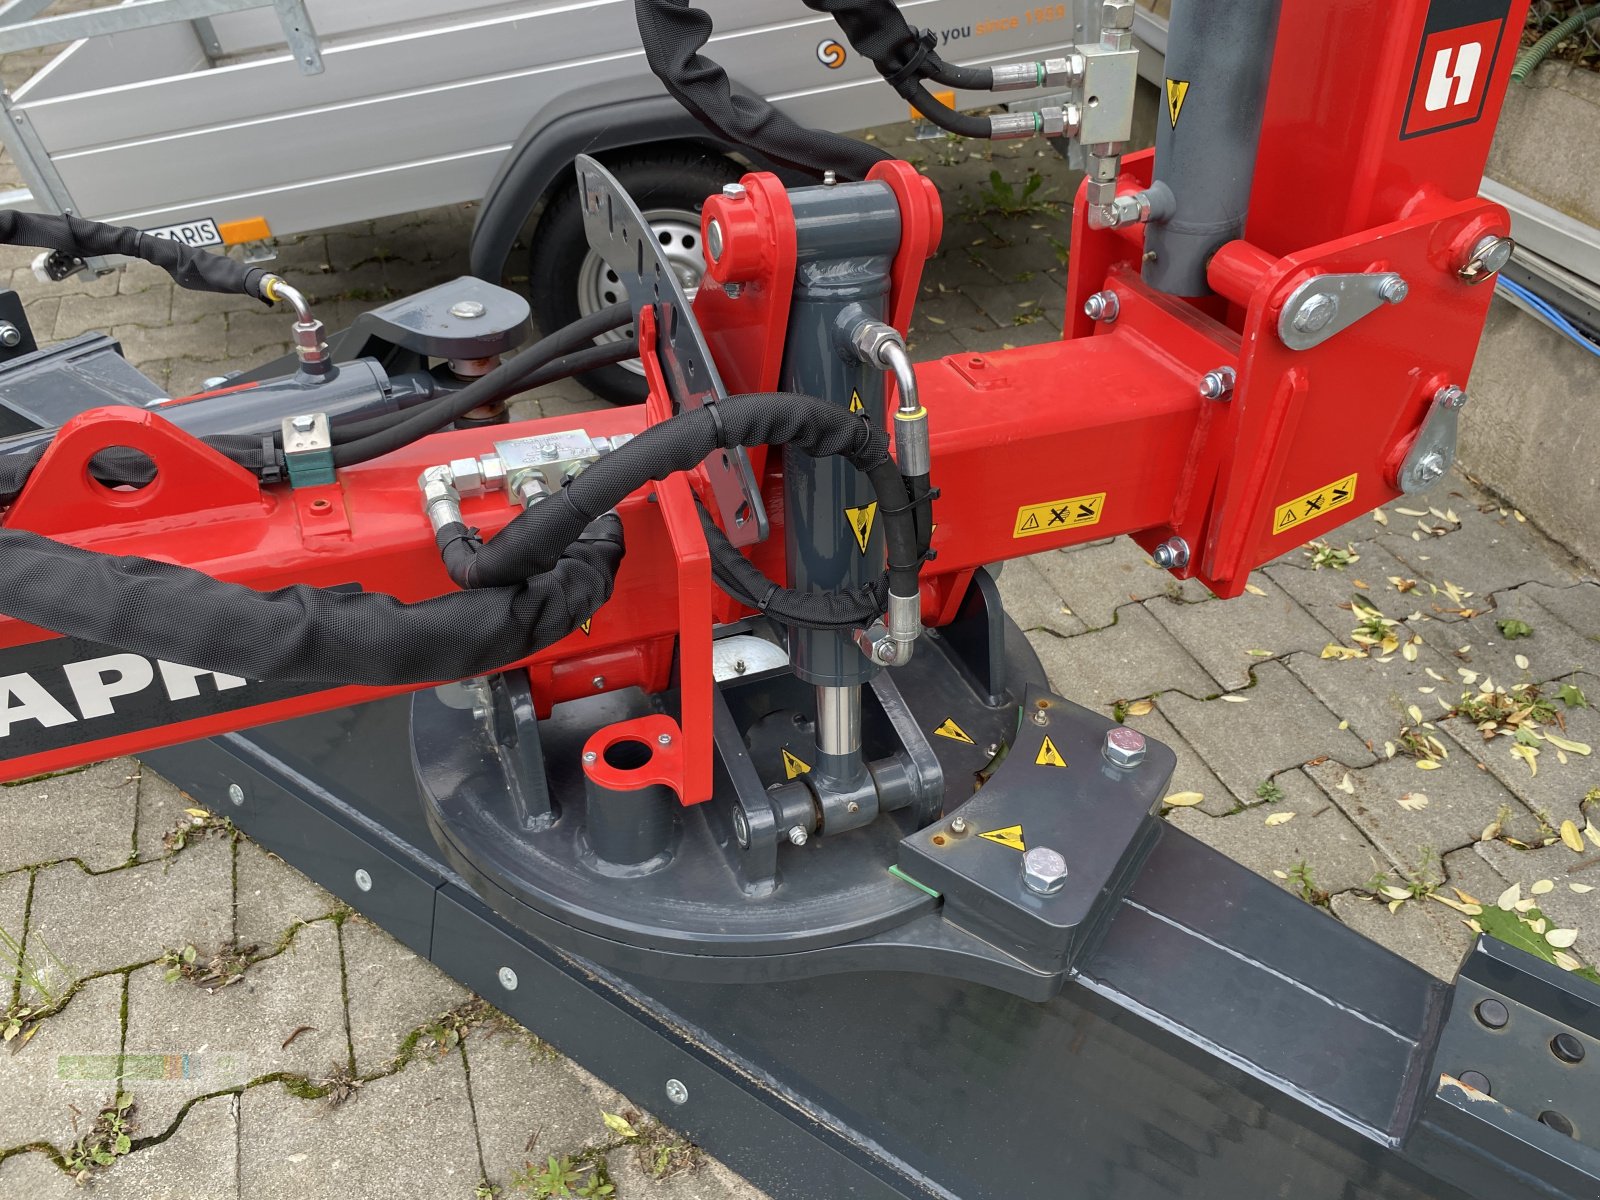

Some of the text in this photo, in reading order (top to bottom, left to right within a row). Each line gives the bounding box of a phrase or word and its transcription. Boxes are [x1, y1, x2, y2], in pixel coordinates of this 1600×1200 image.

[941, 25, 971, 46] you
[975, 15, 1020, 36] since
[154, 224, 216, 245] ARIS
